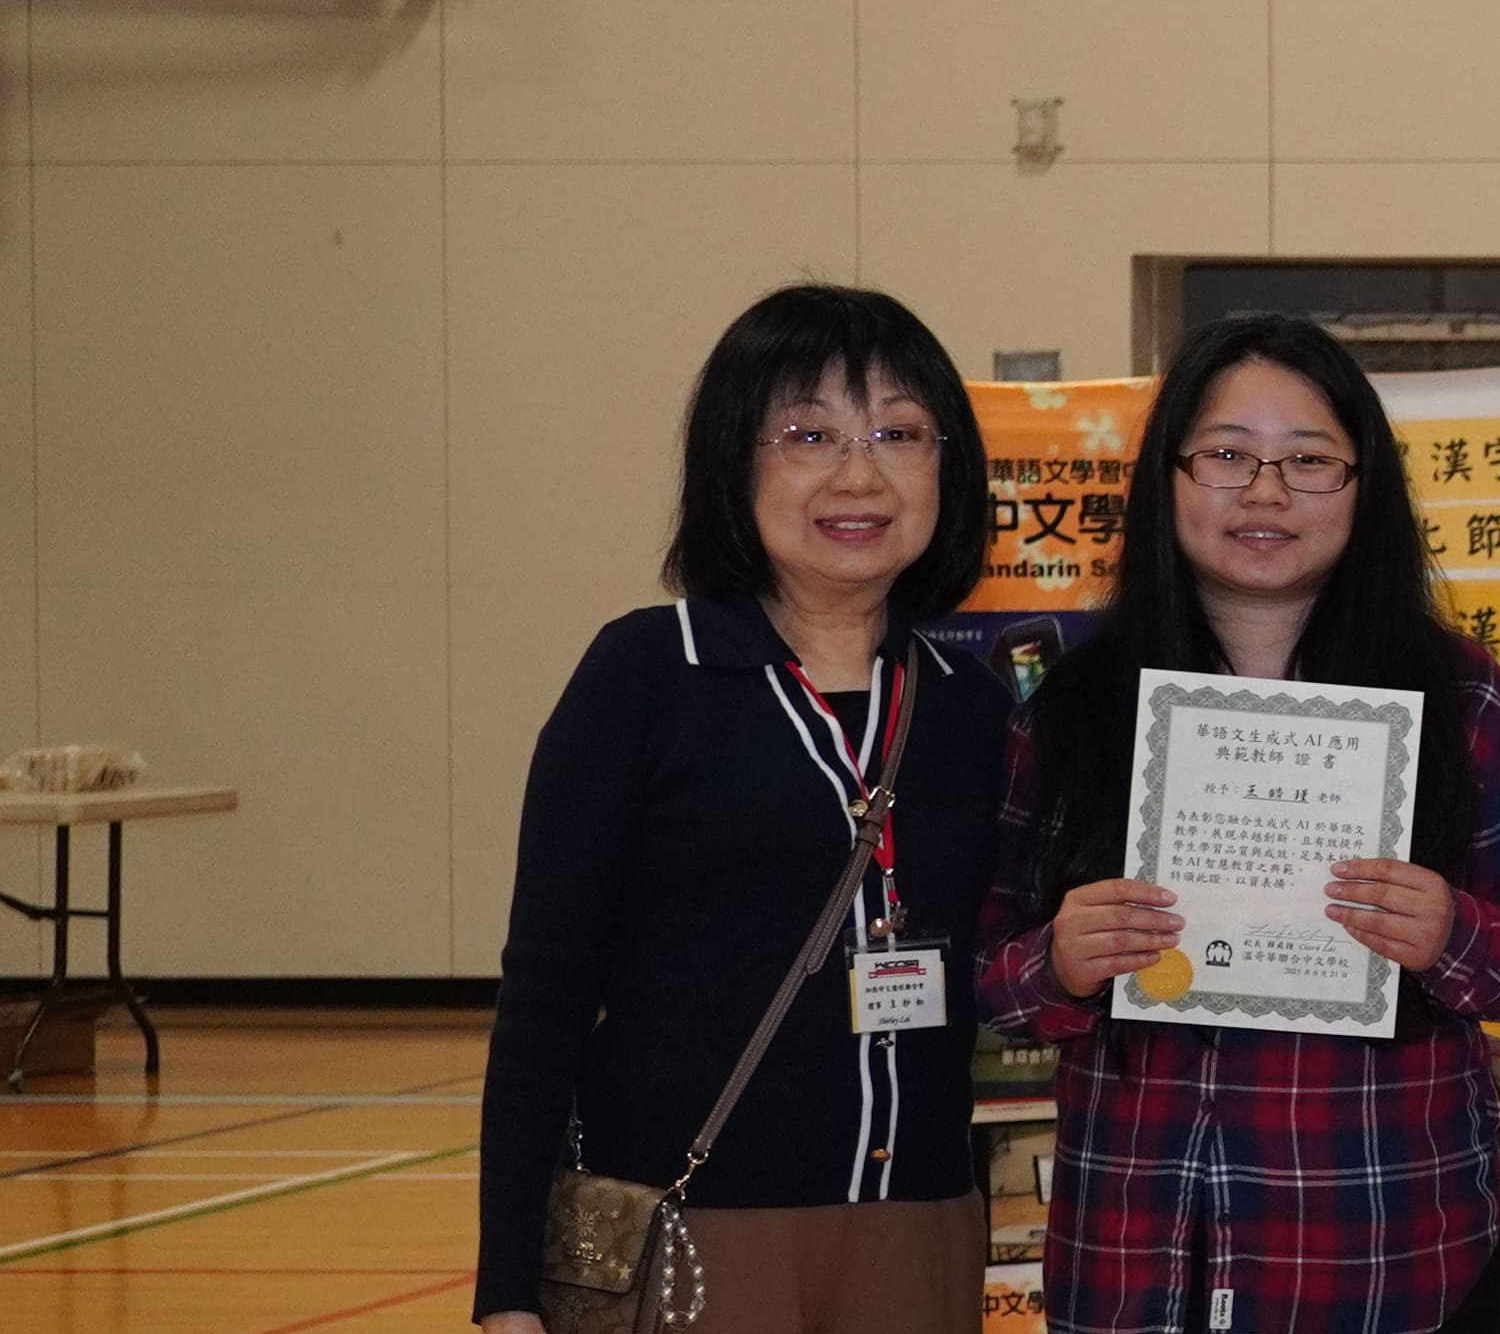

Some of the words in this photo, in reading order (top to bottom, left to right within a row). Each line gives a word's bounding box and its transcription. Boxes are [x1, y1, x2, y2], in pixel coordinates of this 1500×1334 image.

[1195, 723, 1298, 747] 華語文生成式
[1304, 735, 1322, 747] AI
[1327, 736, 1360, 751] 應用
[1215, 746, 1284, 765] 典範教師
[1296, 820, 1310, 830] AI
